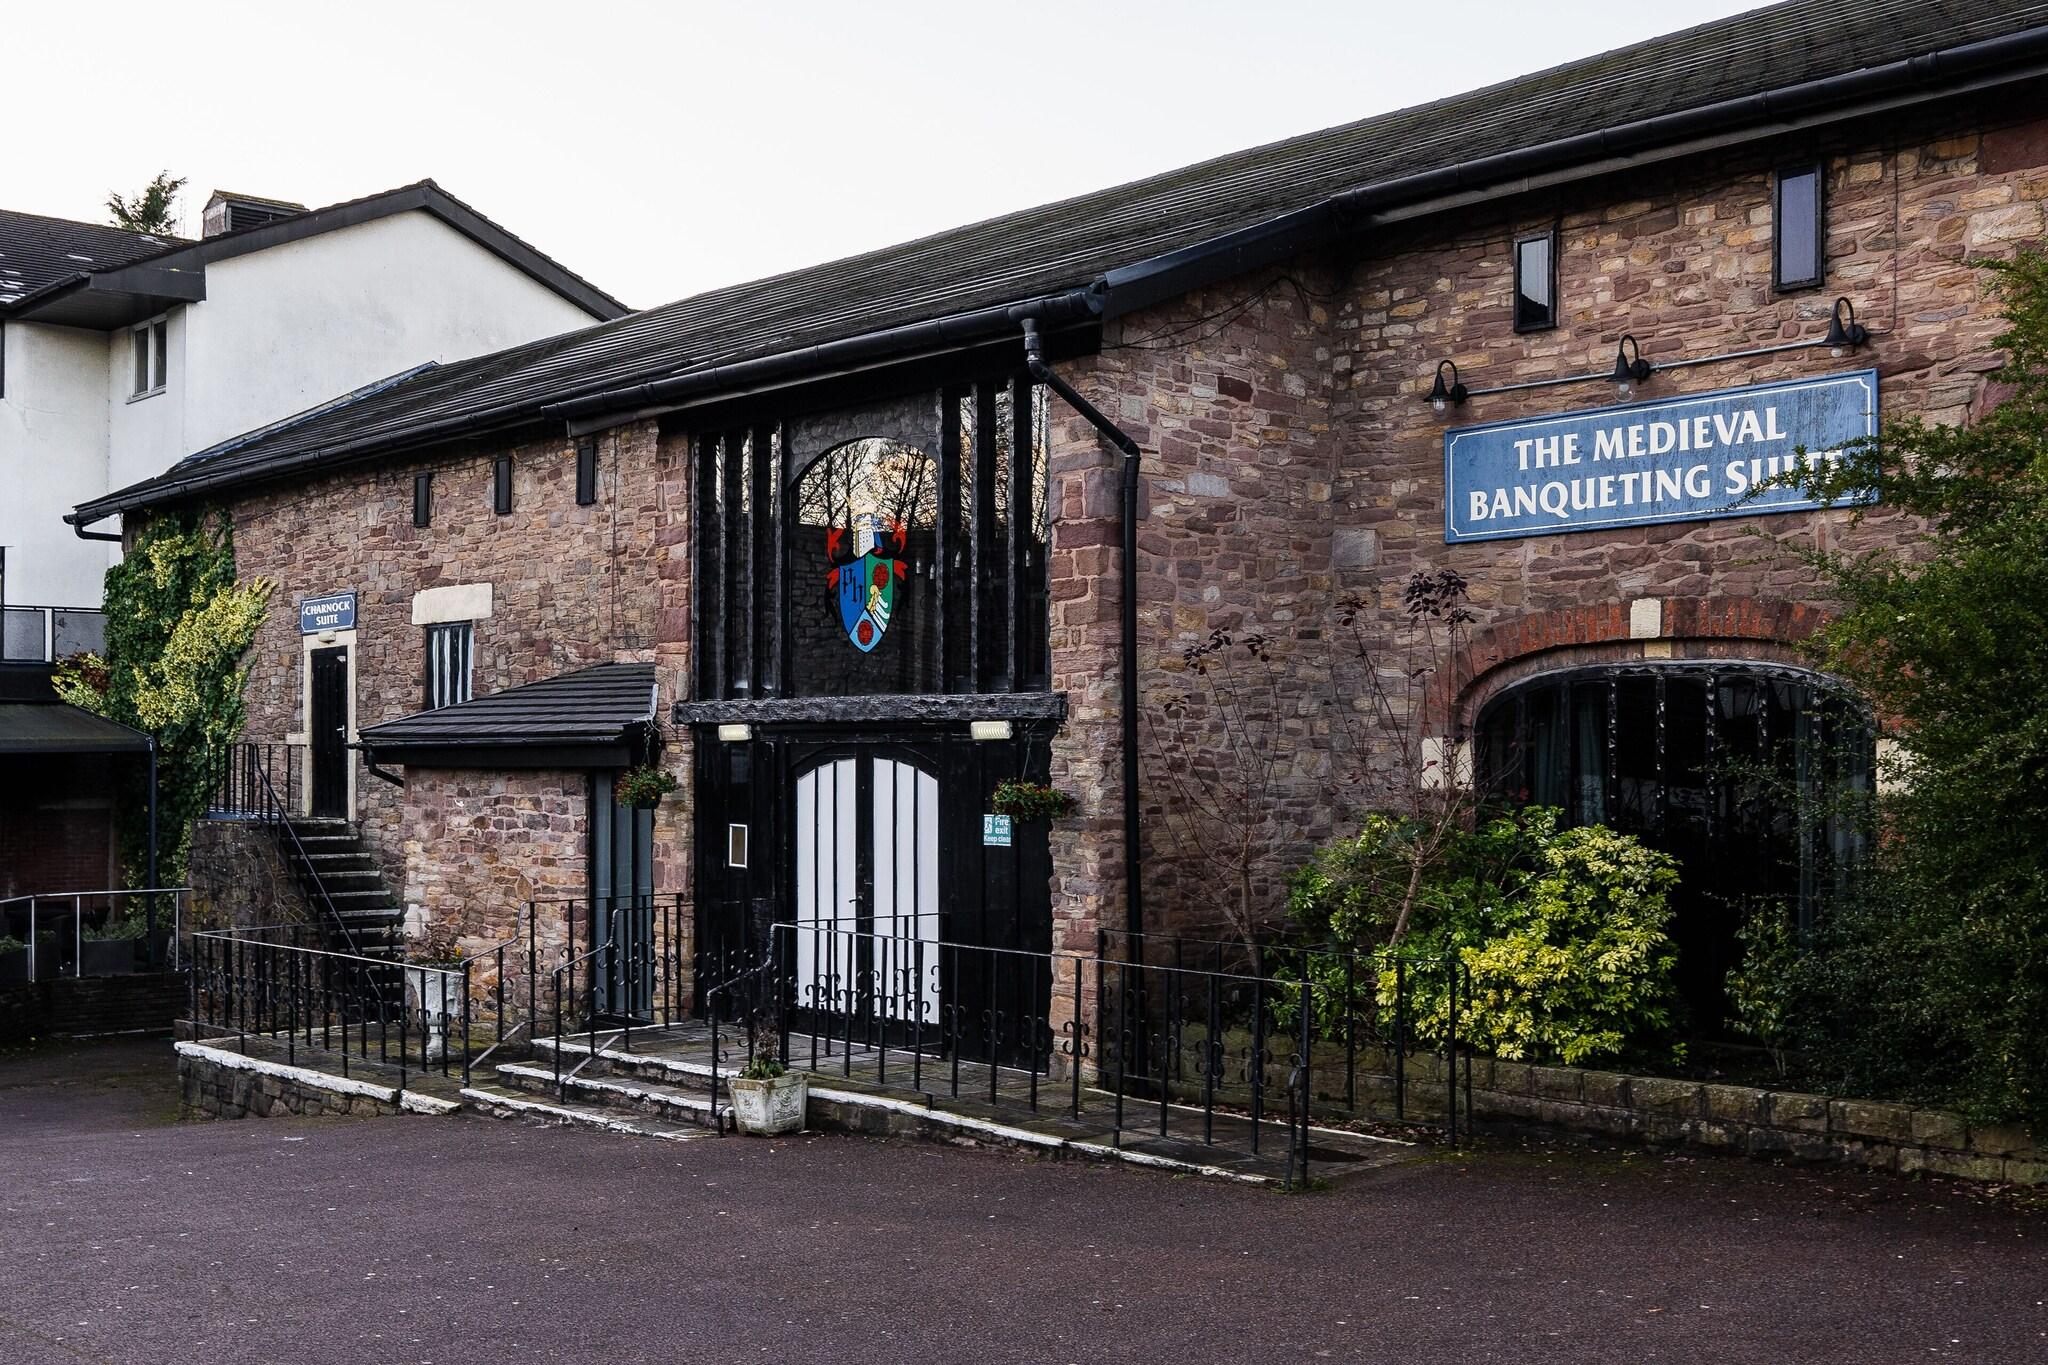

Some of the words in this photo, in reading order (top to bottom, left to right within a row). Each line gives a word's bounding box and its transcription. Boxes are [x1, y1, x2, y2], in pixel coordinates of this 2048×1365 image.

[1514, 433, 1581, 471] THE
[1593, 407, 1787, 462] MEDIEVAL
[1469, 465, 1711, 521] BANQUETING
[305, 601, 351, 616] CHARNOCK
[315, 614, 339, 626] SUITE
[995, 817, 1009, 826] Fire
[995, 826, 1009, 835] exit
